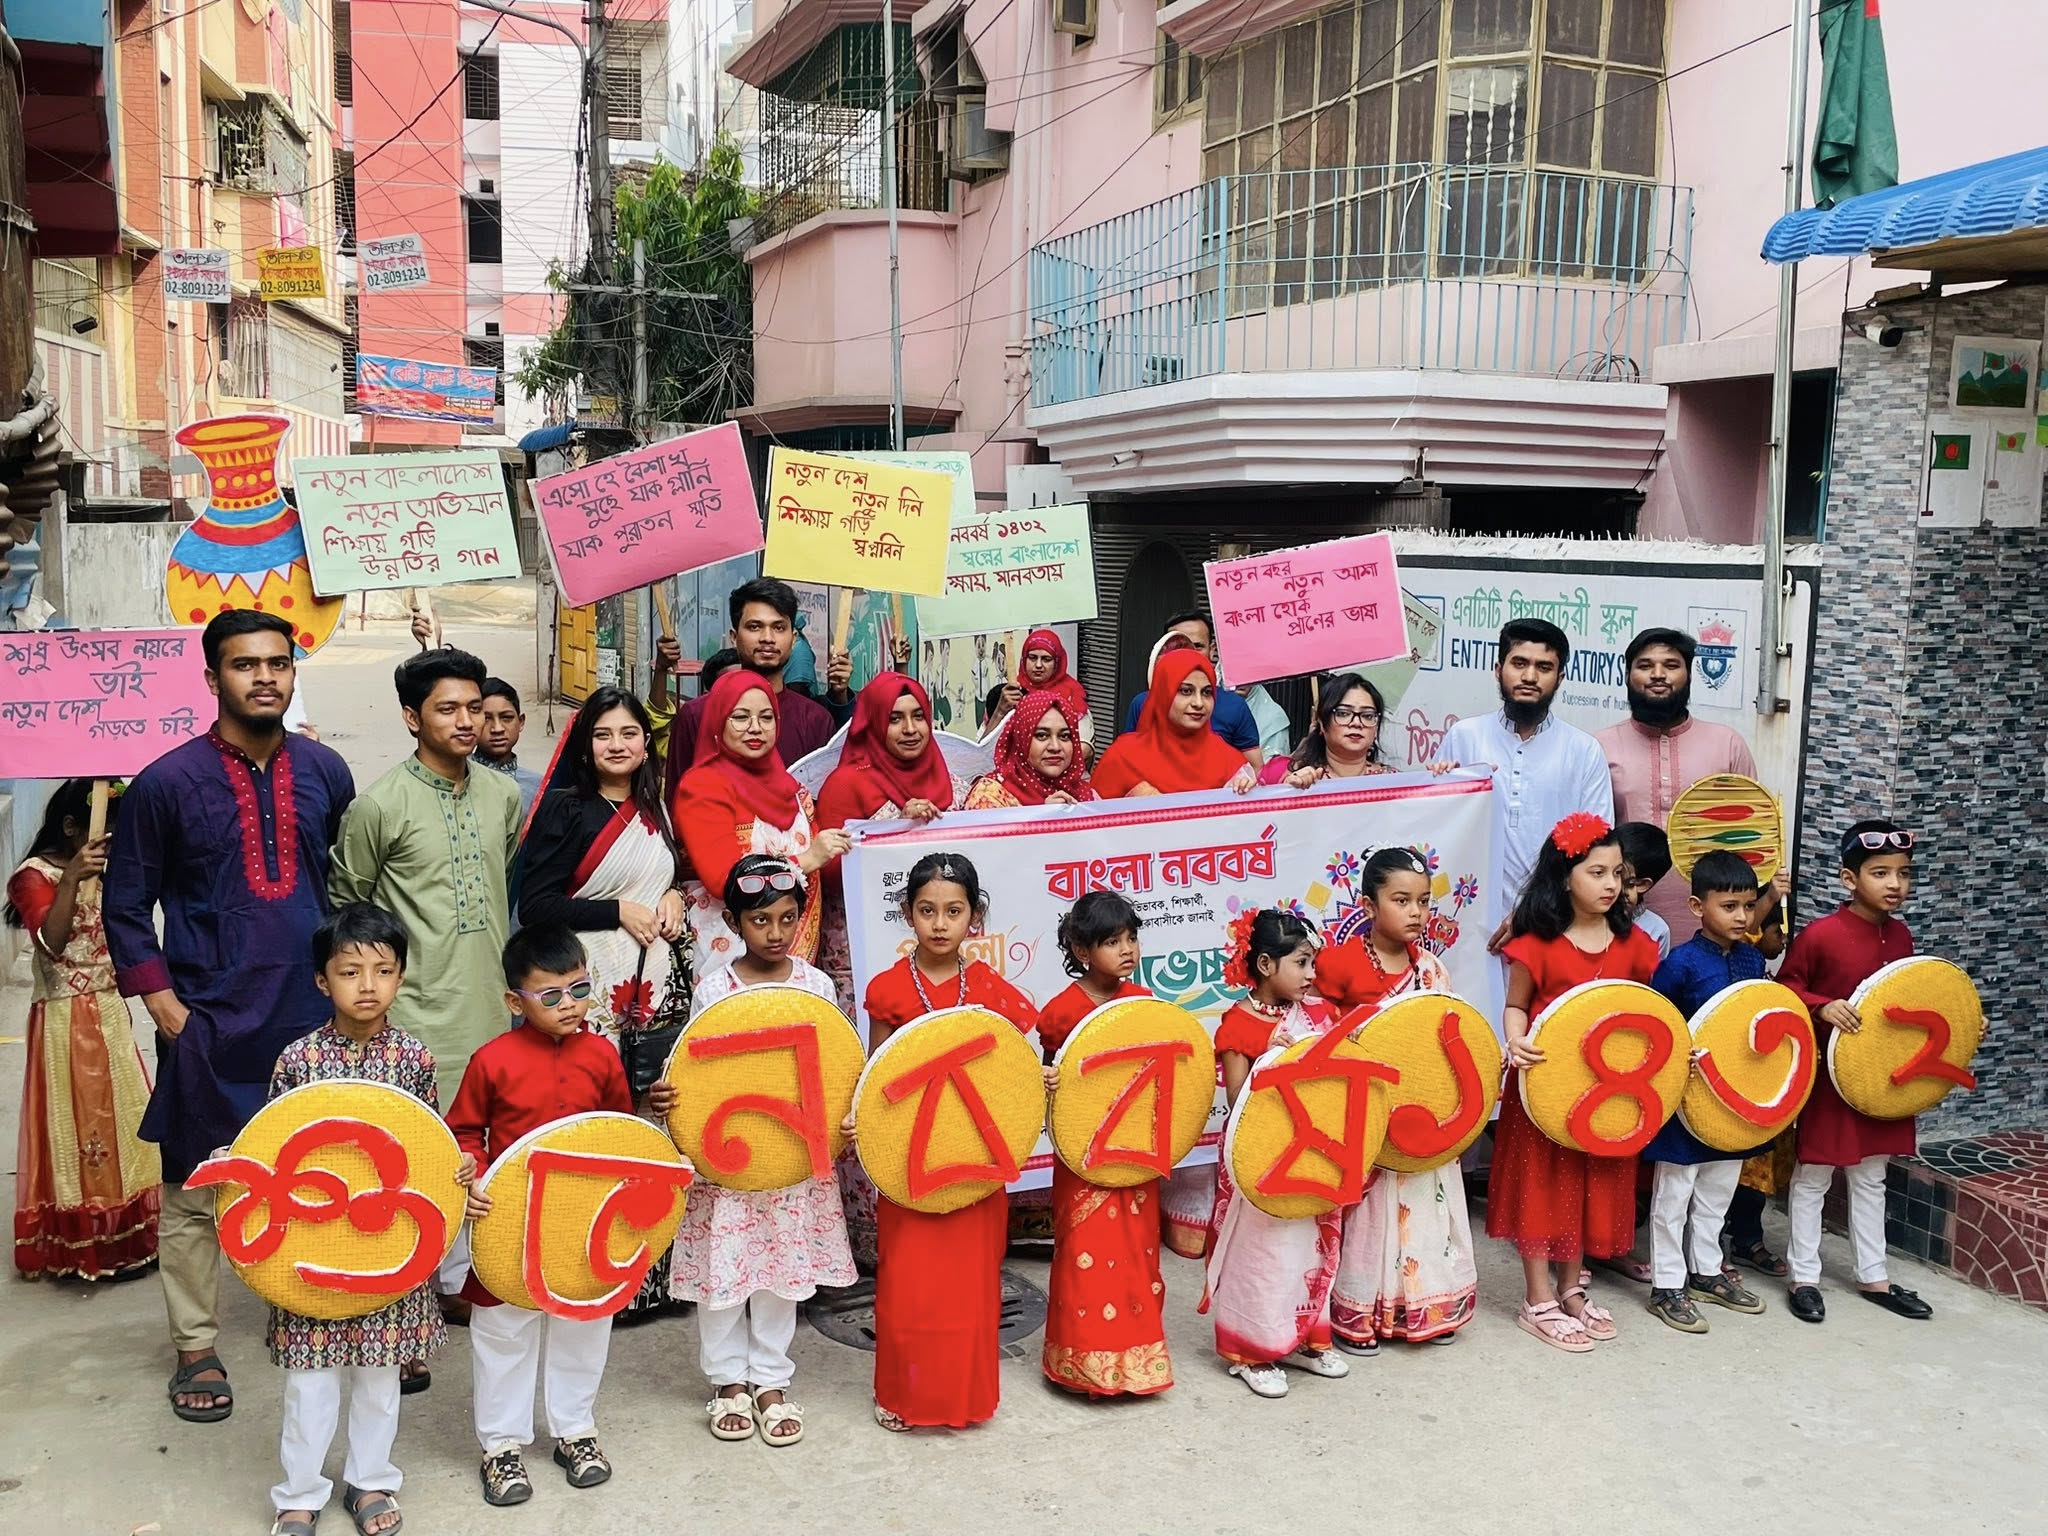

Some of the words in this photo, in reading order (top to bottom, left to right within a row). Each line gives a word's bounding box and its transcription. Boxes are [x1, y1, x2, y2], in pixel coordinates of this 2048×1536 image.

[165, 281, 227, 296] 02-8091234
[261, 280, 321, 293] 02-8091234
[367, 267, 426, 287] 02-8091234
[299, 469, 371, 499] নতুন
[374, 462, 497, 489] বাংলাদেশ
[542, 479, 591, 509] এসো
[595, 470, 622, 493] হে
[627, 480, 663, 504] যাক
[785, 462, 831, 487] নতুন
[834, 469, 869, 491] দেশ
[343, 501, 401, 528] নতুন
[405, 491, 504, 519] অভিযান
[776, 495, 834, 529] শিক্ষায়
[852, 491, 890, 517] নতুন
[897, 486, 924, 517] দিন
[323, 525, 387, 555] শিক্ষায়
[400, 521, 436, 550] গড়ি
[558, 535, 604, 559] যাক
[613, 510, 675, 554] পুরাতন
[950, 517, 990, 544] নববর্ষ
[996, 520, 1047, 538] ১৪৩২
[457, 547, 500, 566] গান
[960, 547, 1003, 568] স্বপ্নের
[1008, 539, 1080, 564] বাংলাদেশ
[993, 562, 1066, 588] মানবতায়
[1215, 566, 1258, 591] নতুন
[1261, 560, 1292, 580] বছর
[1283, 571, 1324, 598] নতুন
[1332, 562, 1378, 581] আশা
[1224, 605, 1266, 628] বাংলা
[1270, 598, 1311, 619] হোক
[1341, 602, 1378, 623] ভাষা
[1451, 586, 1502, 629] এনটিটি
[1600, 604, 1639, 645] স্কুল
[3, 640, 52, 676] শুধু
[56, 635, 122, 662] উৎসব
[1451, 638, 1500, 671] ENTIT
[89, 661, 157, 698] ভাই
[1, 700, 51, 729] নতুন
[54, 698, 108, 725] দেশ
[1602, 695, 1611, 709] of
[88, 719, 147, 740] গড়তে
[159, 706, 199, 737] চাই
[1044, 851, 1153, 901] বাংলা
[1159, 823, 1277, 887] নববর্ষ
[1133, 900, 1168, 912] ভিভাবক,
[1187, 909, 1215, 923] জানাই
